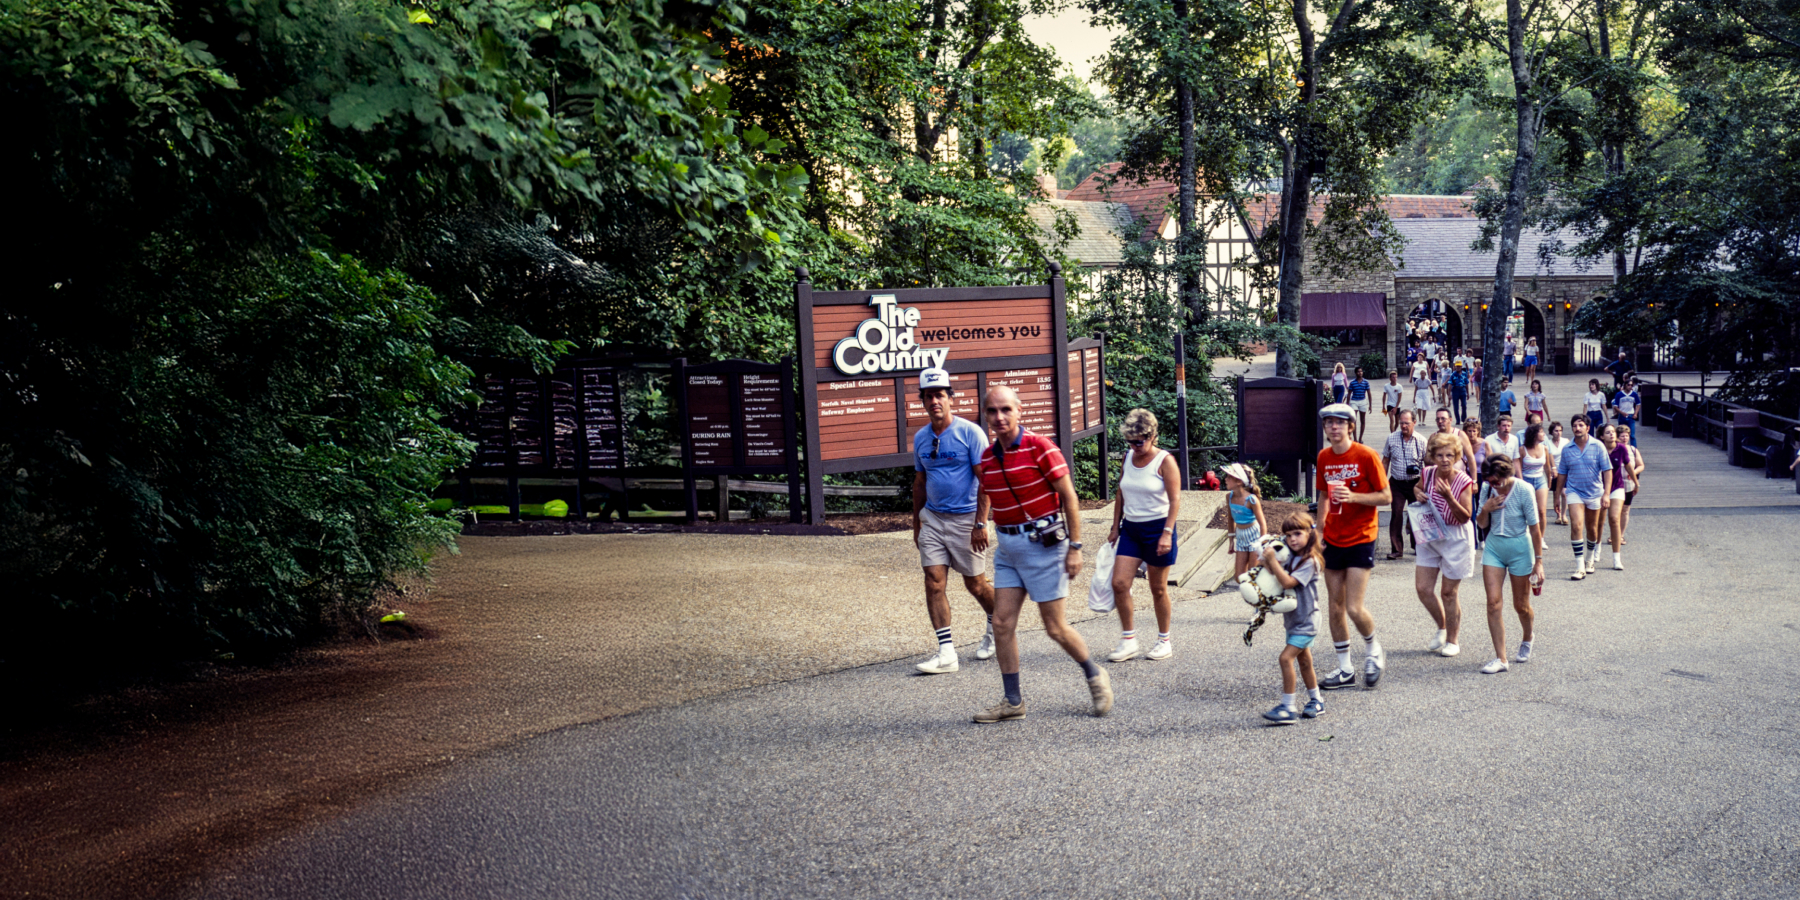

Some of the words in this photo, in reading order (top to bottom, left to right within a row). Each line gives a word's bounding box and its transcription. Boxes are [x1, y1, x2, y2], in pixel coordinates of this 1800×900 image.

[869, 294, 921, 327] The
[857, 318, 917, 353] Old
[921, 327, 1005, 342] welcomes
[1009, 325, 1041, 340] you
[833, 337, 950, 375] Country
[830, 381, 855, 390] Special
